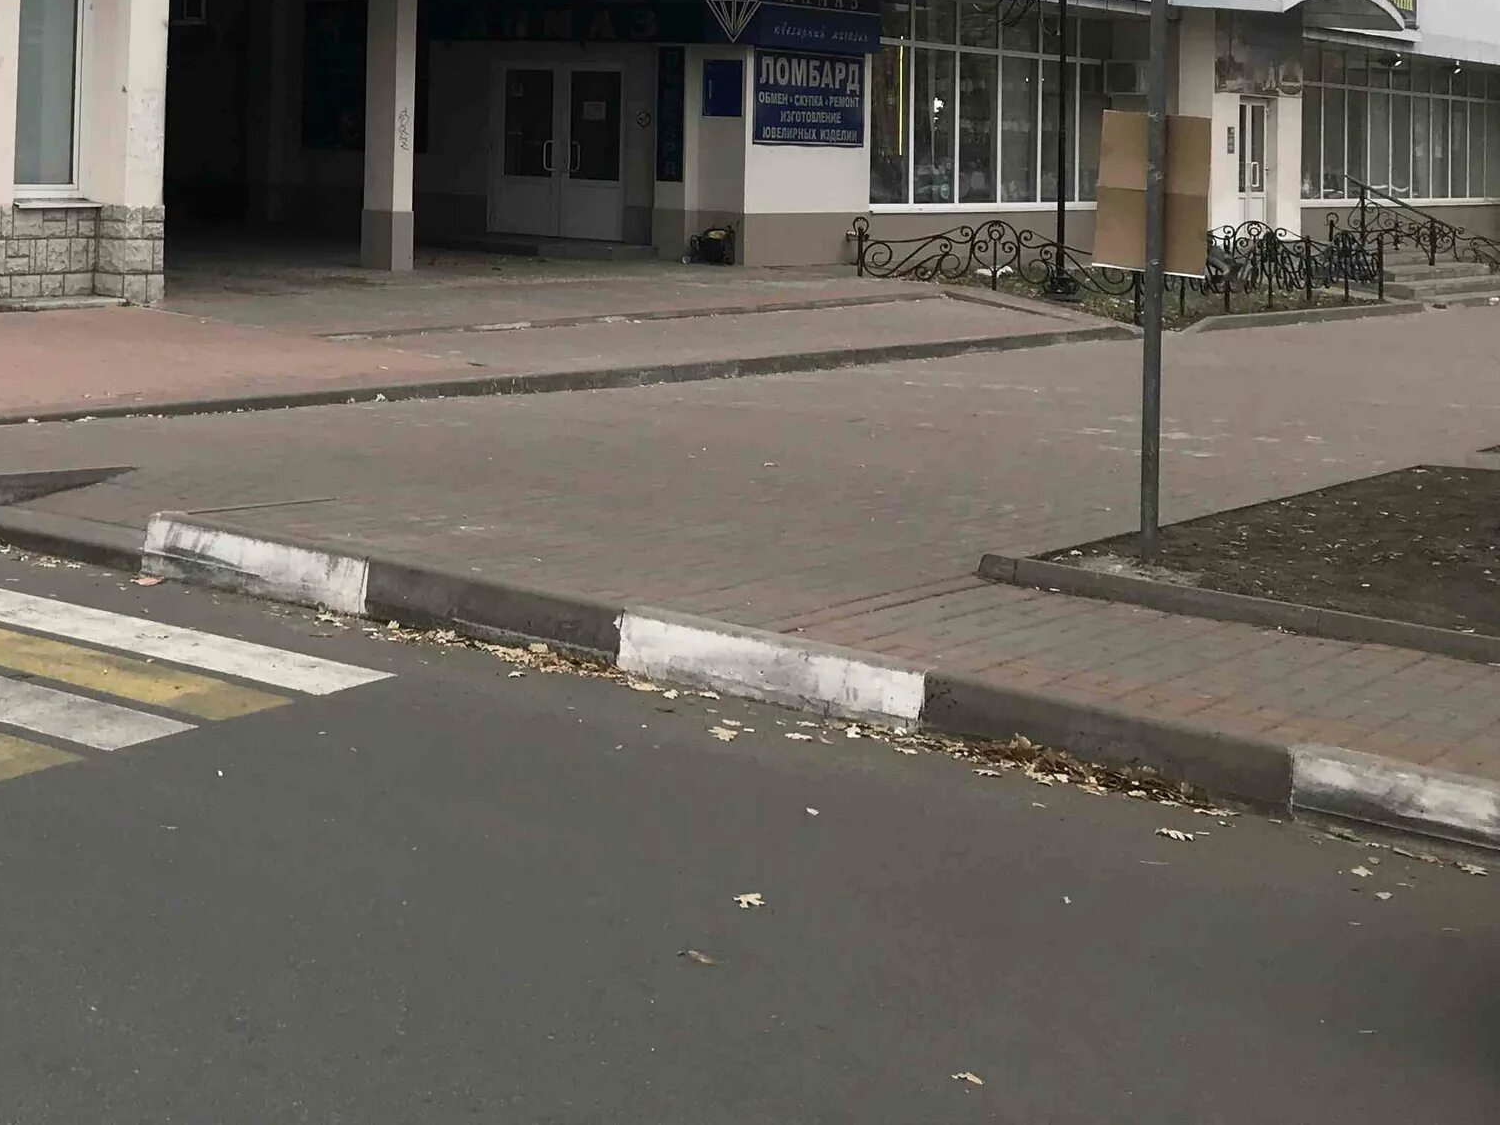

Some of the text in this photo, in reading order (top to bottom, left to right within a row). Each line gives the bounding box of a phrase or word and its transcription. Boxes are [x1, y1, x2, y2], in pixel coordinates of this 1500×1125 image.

[759, 55, 861, 95] ЛОМБАРД
[758, 91, 860, 109] ОБМЕН СКУПКА РЕМОНТ
[780, 111, 842, 125] ИЗГОТОВЛЕНИЕ
[762, 126, 817, 141] ЮВЕЛИРНЫХ
